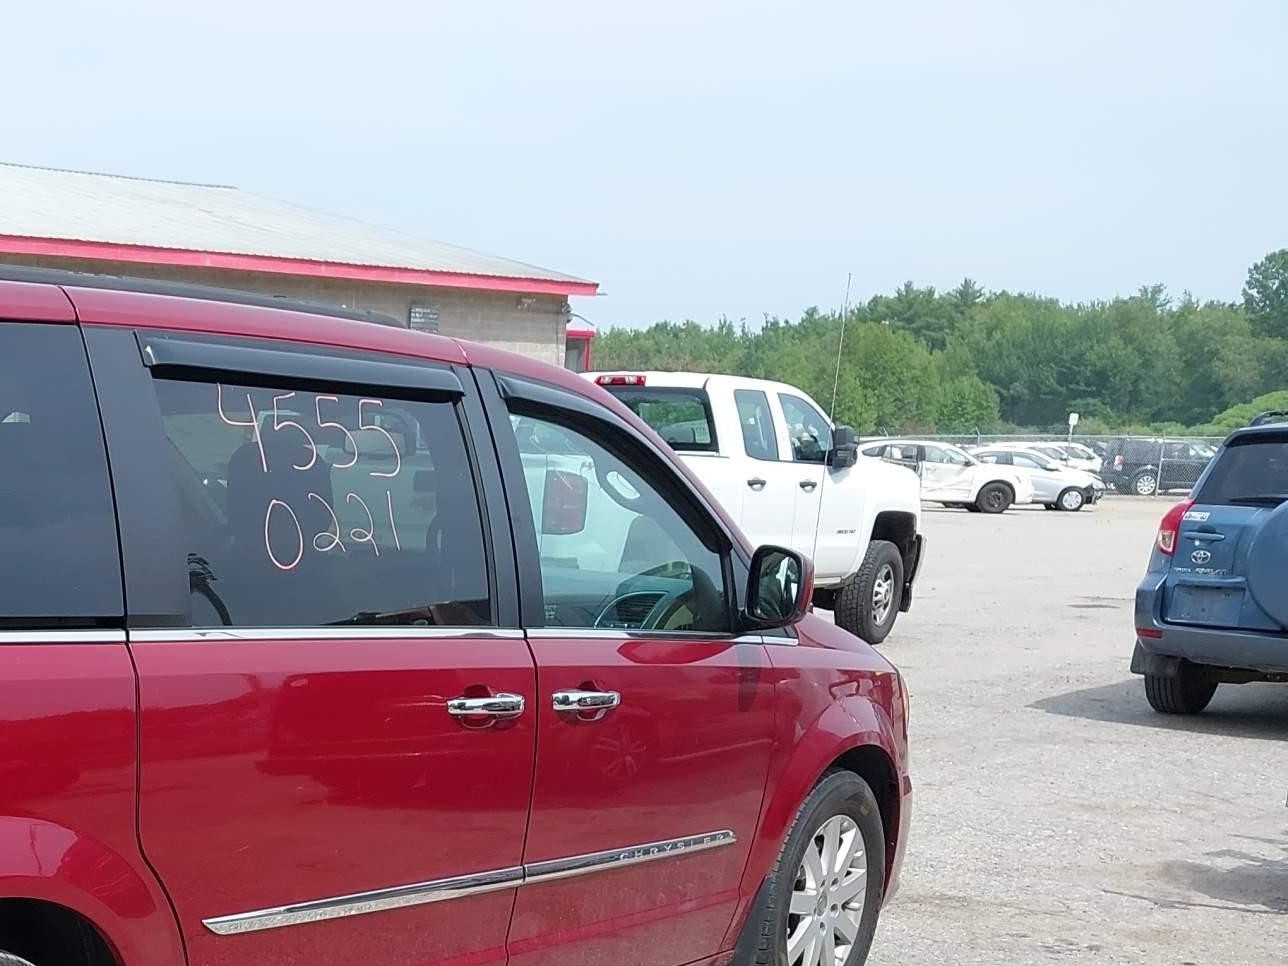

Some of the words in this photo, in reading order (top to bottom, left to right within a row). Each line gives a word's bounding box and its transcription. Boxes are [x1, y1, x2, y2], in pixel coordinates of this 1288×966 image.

[217, 382, 401, 477] 4555
[265, 490, 401, 570] 0221
[620, 833, 725, 861] CHRYSLER
